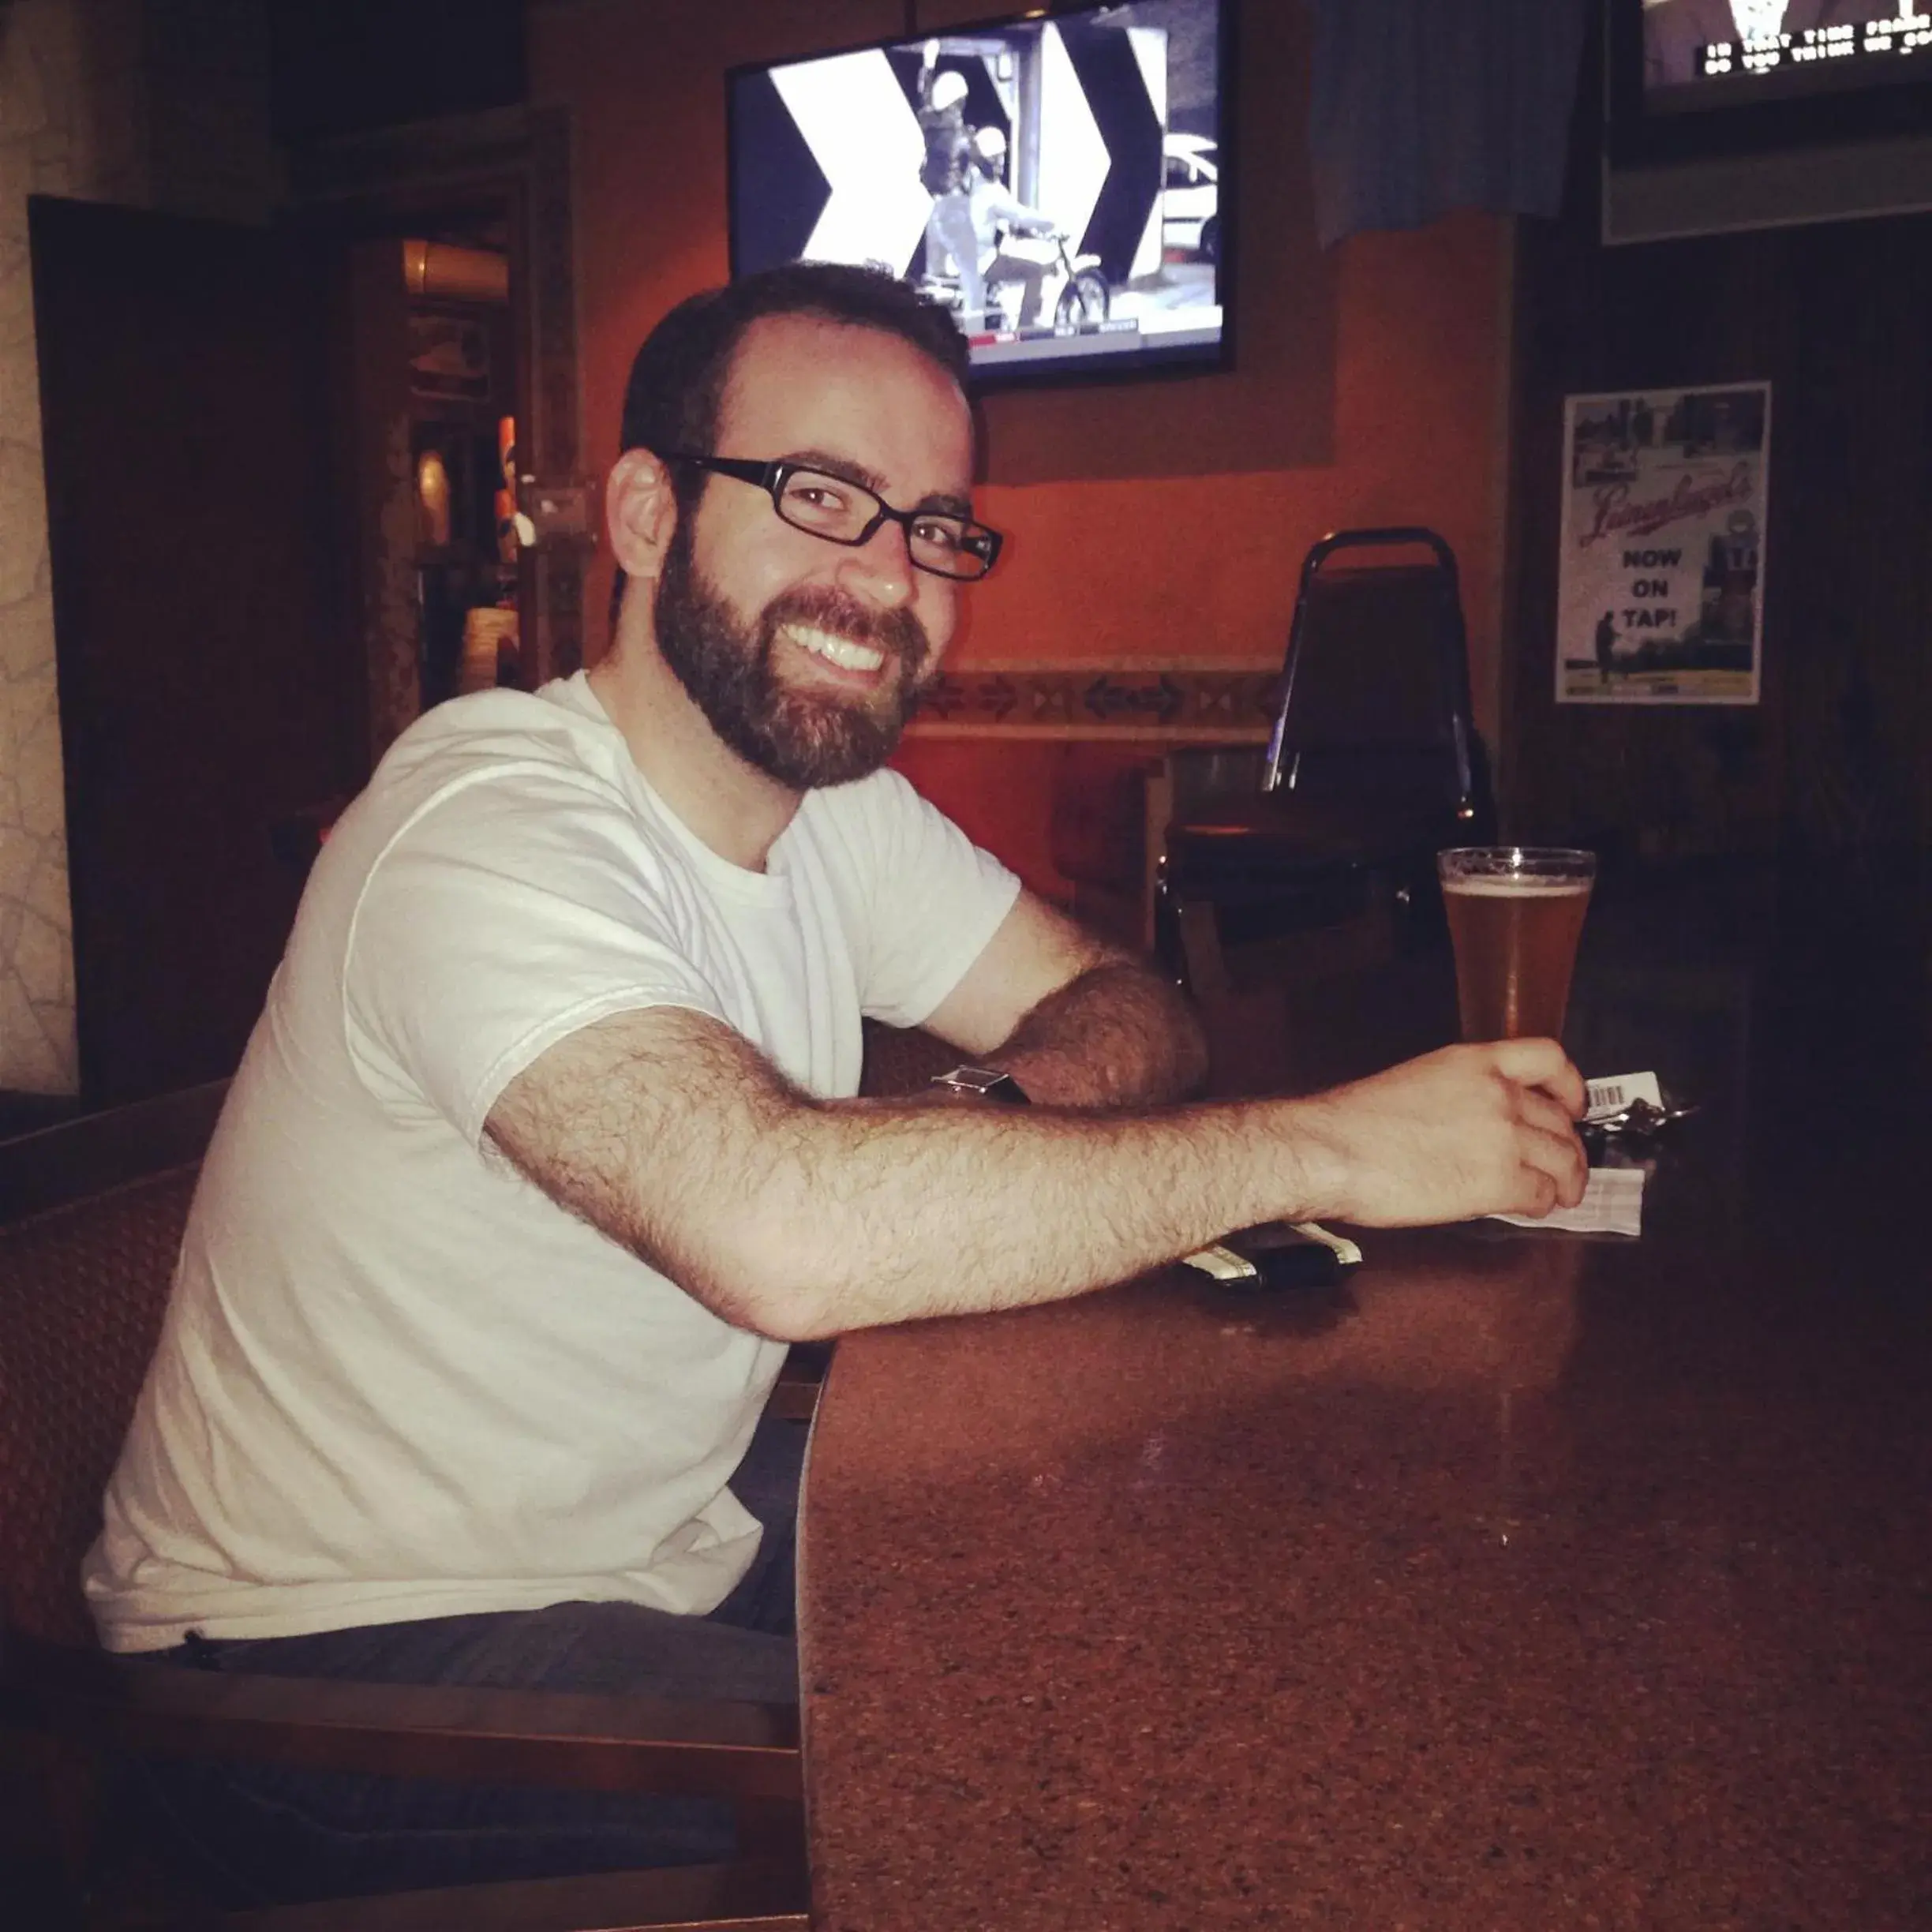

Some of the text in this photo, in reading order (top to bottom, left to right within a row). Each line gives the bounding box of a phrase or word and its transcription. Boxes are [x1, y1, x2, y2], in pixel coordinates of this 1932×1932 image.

[1804, 24, 1854, 44] TIME
[1742, 52, 1780, 69] YOU
[1792, 41, 1854, 62] THINK
[1623, 549, 1681, 569] NOW
[1631, 579, 1668, 597] ON
[1621, 609, 1677, 628] TAP!
